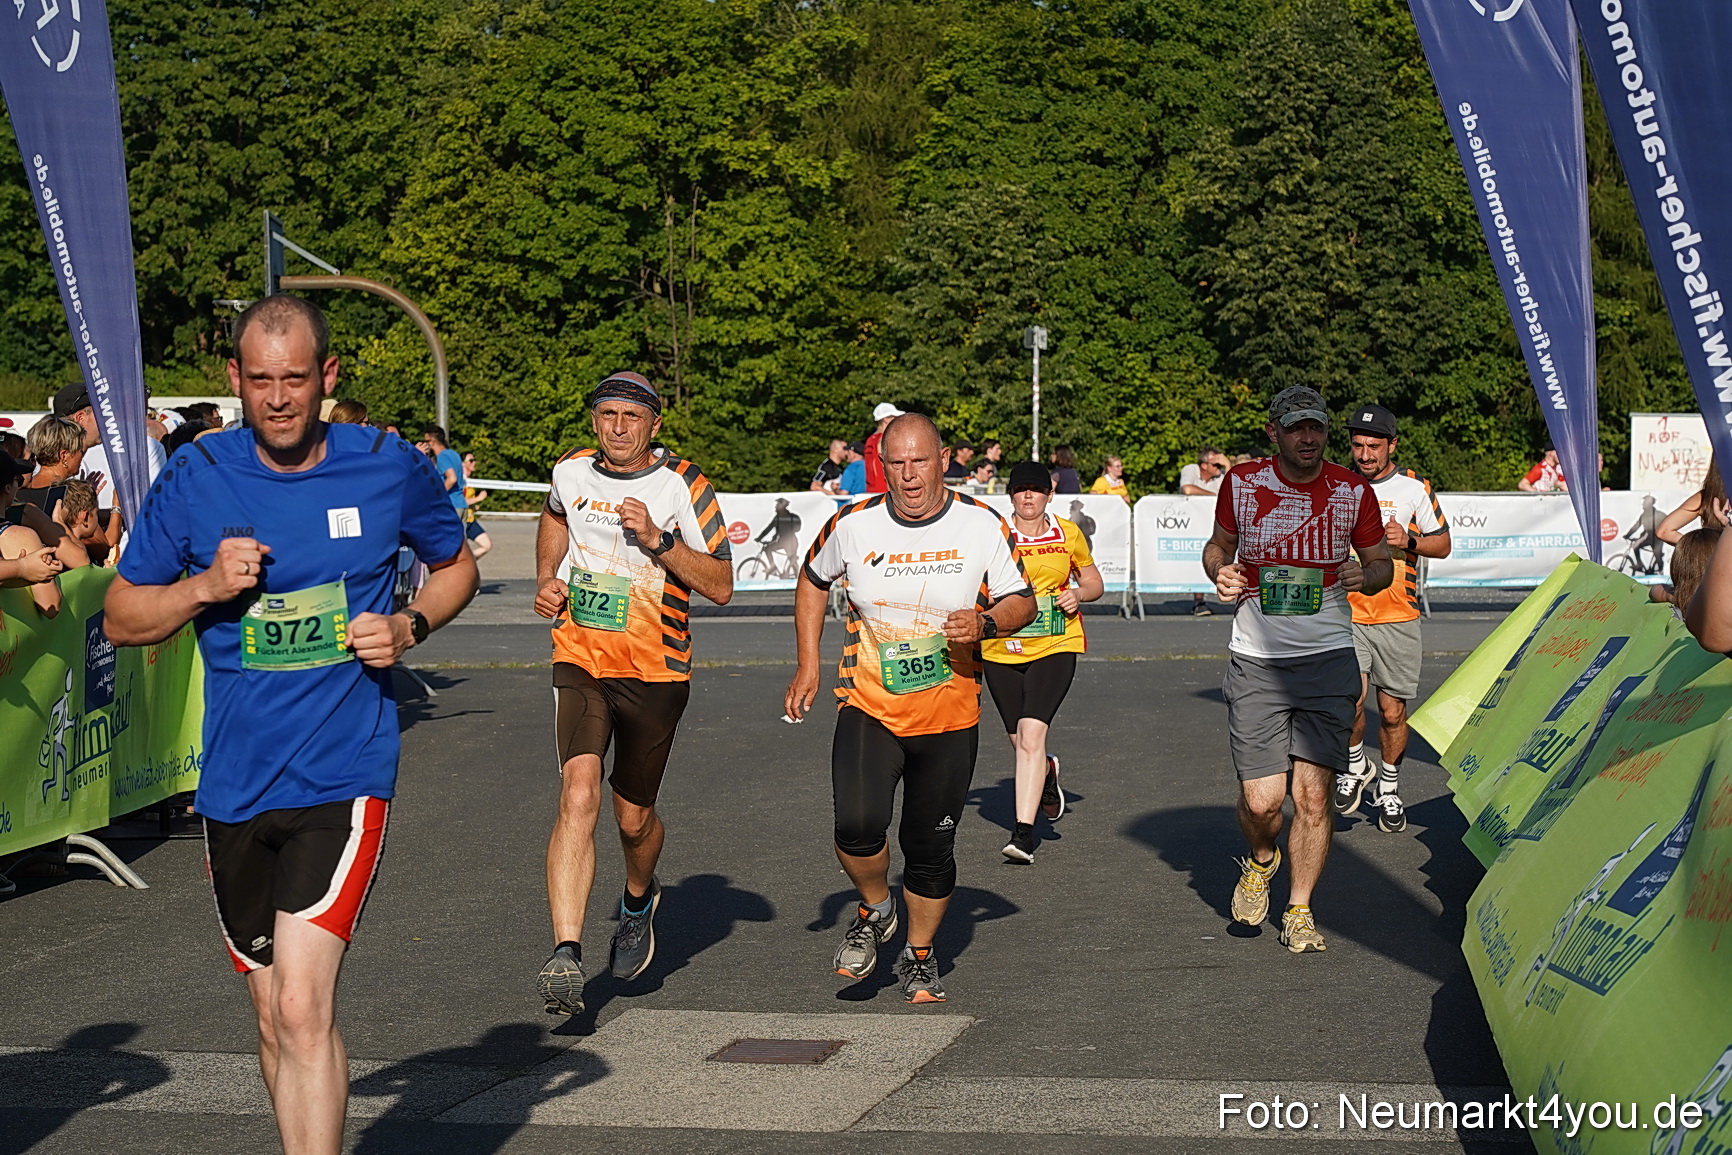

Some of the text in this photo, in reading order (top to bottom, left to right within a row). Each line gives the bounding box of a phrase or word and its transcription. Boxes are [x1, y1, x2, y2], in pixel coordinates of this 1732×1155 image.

[1157, 517, 1190, 530] NOW
[1453, 515, 1488, 528] NOW
[221, 526, 254, 538] JAKO
[1037, 545, 1068, 556] BÖGL
[1455, 537, 1503, 549] E-BIKES
[1506, 537, 1515, 548] &
[888, 549, 965, 564] KLEBL
[884, 562, 964, 578] DYNAMICS
[1269, 583, 1311, 601] 1131
[1313, 587, 1321, 610] 2022
[577, 589, 610, 612] 372
[1284, 600, 1310, 608] Matthias
[596, 611, 617, 620] Günter
[615, 598, 625, 624] 2022
[264, 616, 323, 646] 972
[333, 613, 348, 651] 2022
[245, 626, 257, 654] RUN
[291, 641, 337, 655] Alexander
[898, 654, 935, 677] 365
[885, 666, 893, 686] RUN
[922, 671, 936, 681] Uwe
